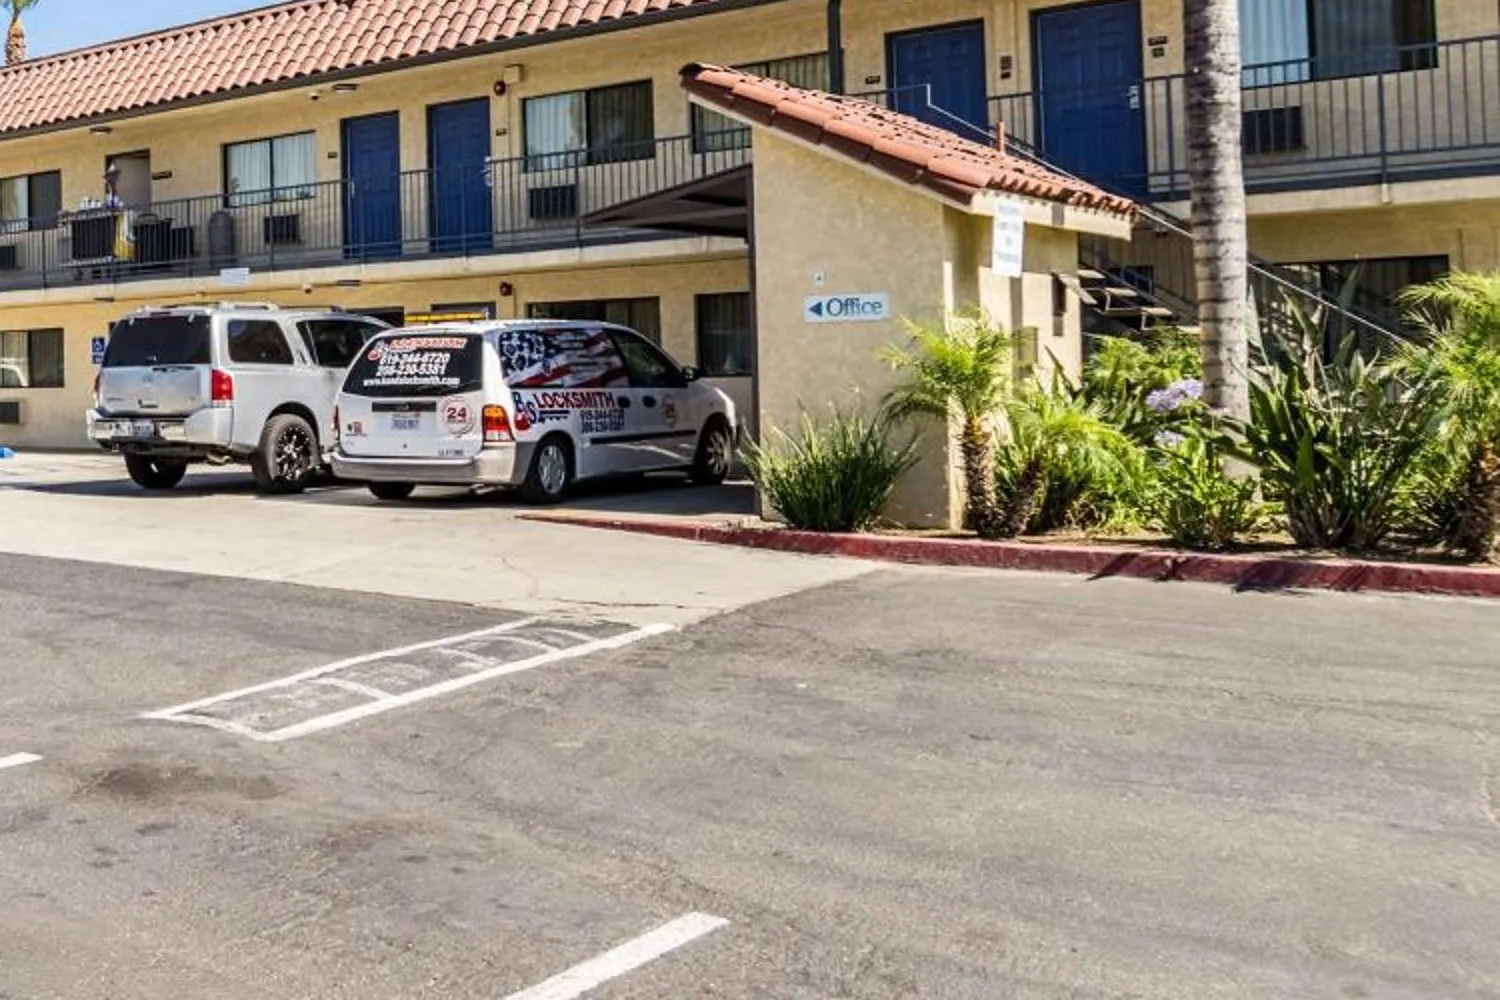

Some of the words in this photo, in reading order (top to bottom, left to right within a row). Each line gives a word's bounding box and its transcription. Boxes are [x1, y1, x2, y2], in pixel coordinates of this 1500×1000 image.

[826, 297, 883, 317] Office
[532, 391, 615, 409] LOCKSMITH
[447, 406, 468, 419] 24
